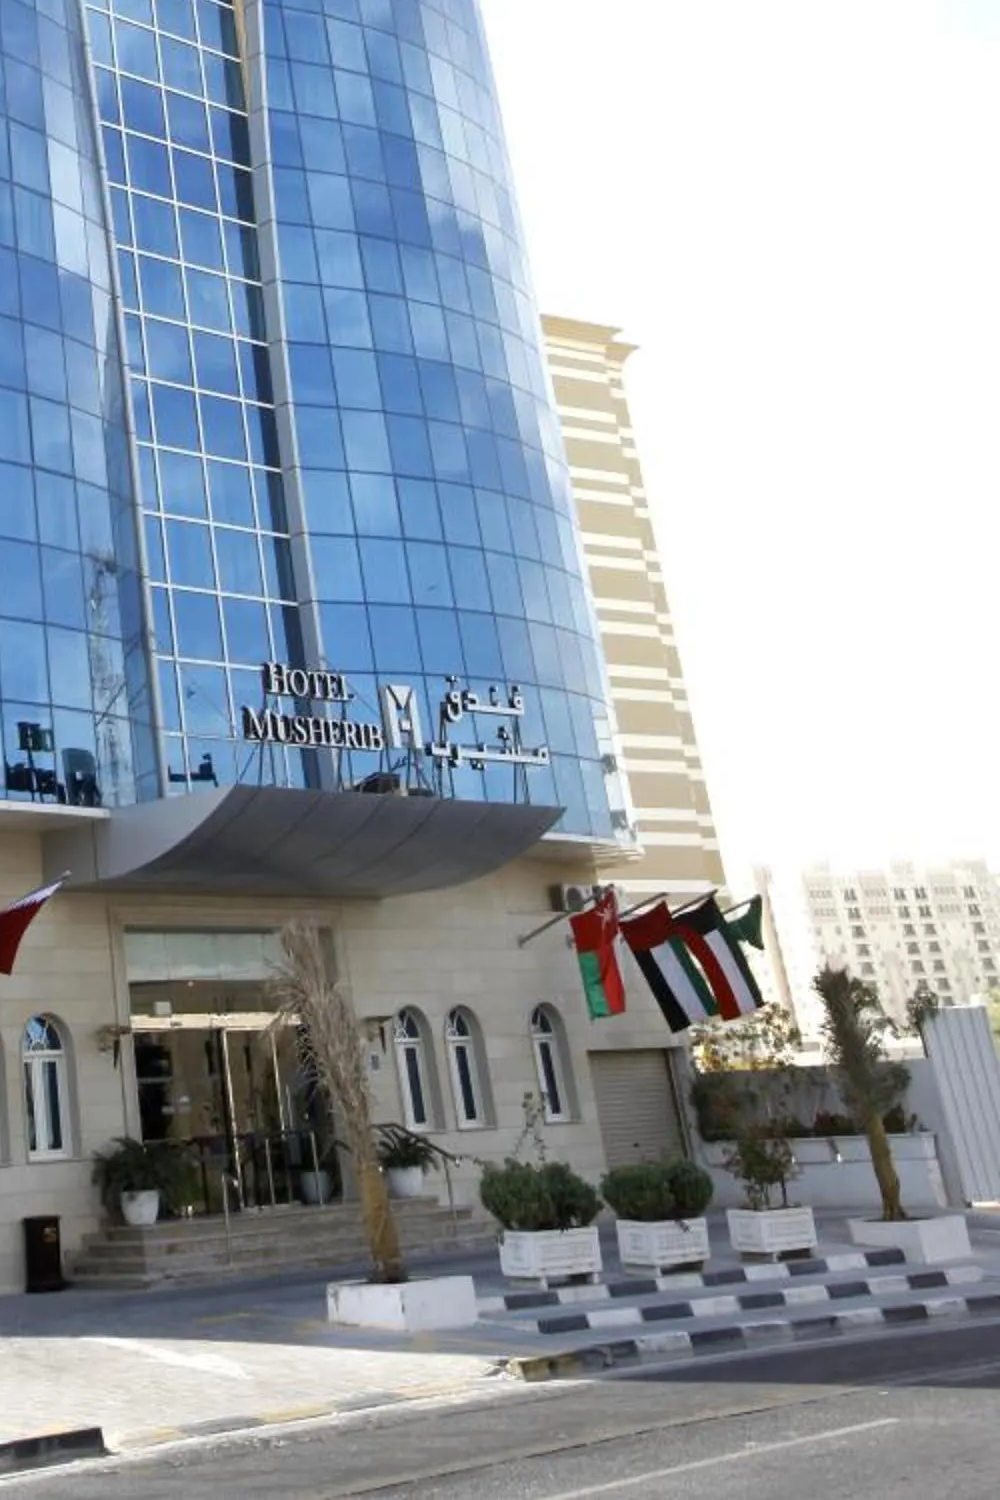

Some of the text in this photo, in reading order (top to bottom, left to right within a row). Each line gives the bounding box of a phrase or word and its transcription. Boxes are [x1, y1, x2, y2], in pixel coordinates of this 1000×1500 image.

[264, 662, 355, 701] HOTEL
[445, 675, 525, 721] فندق
[244, 705, 384, 750] MUSHERIB
[427, 729, 550, 769] مشيرب
